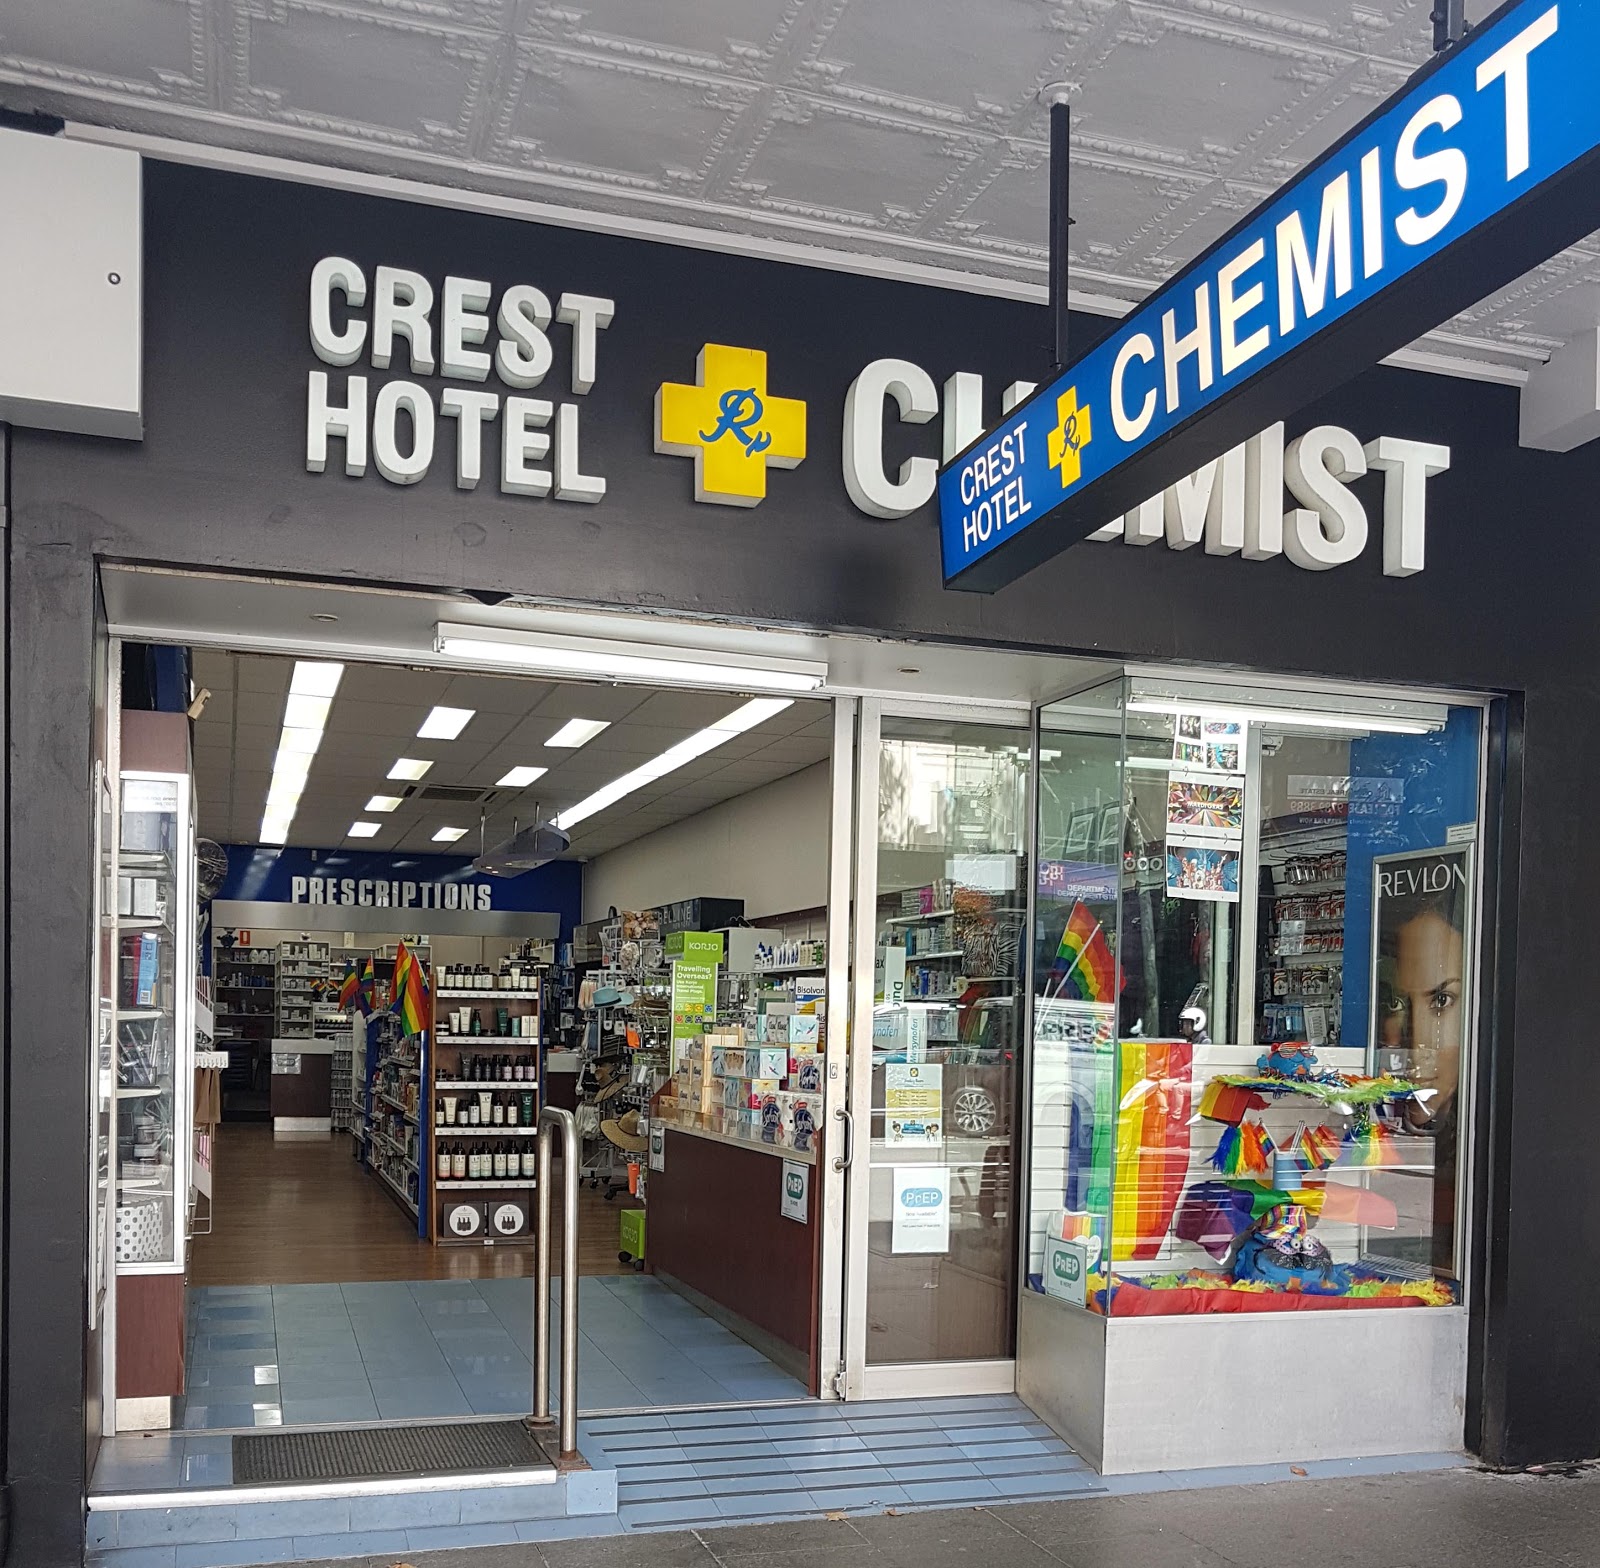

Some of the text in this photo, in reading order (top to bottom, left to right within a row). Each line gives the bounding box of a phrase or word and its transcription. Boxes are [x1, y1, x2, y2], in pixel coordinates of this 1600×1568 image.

[1110, 4, 1559, 443] CHEMIST
[310, 256, 615, 395] CREST
[305, 370, 606, 503] HOTEL
[842, 358, 1451, 578] CMIST
[960, 421, 1028, 506] CREST
[963, 476, 1032, 553] HOTEL
[292, 876, 491, 911] PRESCRIPTIONS
[676, 965, 711, 974] Travelling
[676, 972, 712, 980] Overseas?
[689, 942, 719, 952] KORJO
[906, 1192, 939, 1205] PrEP
